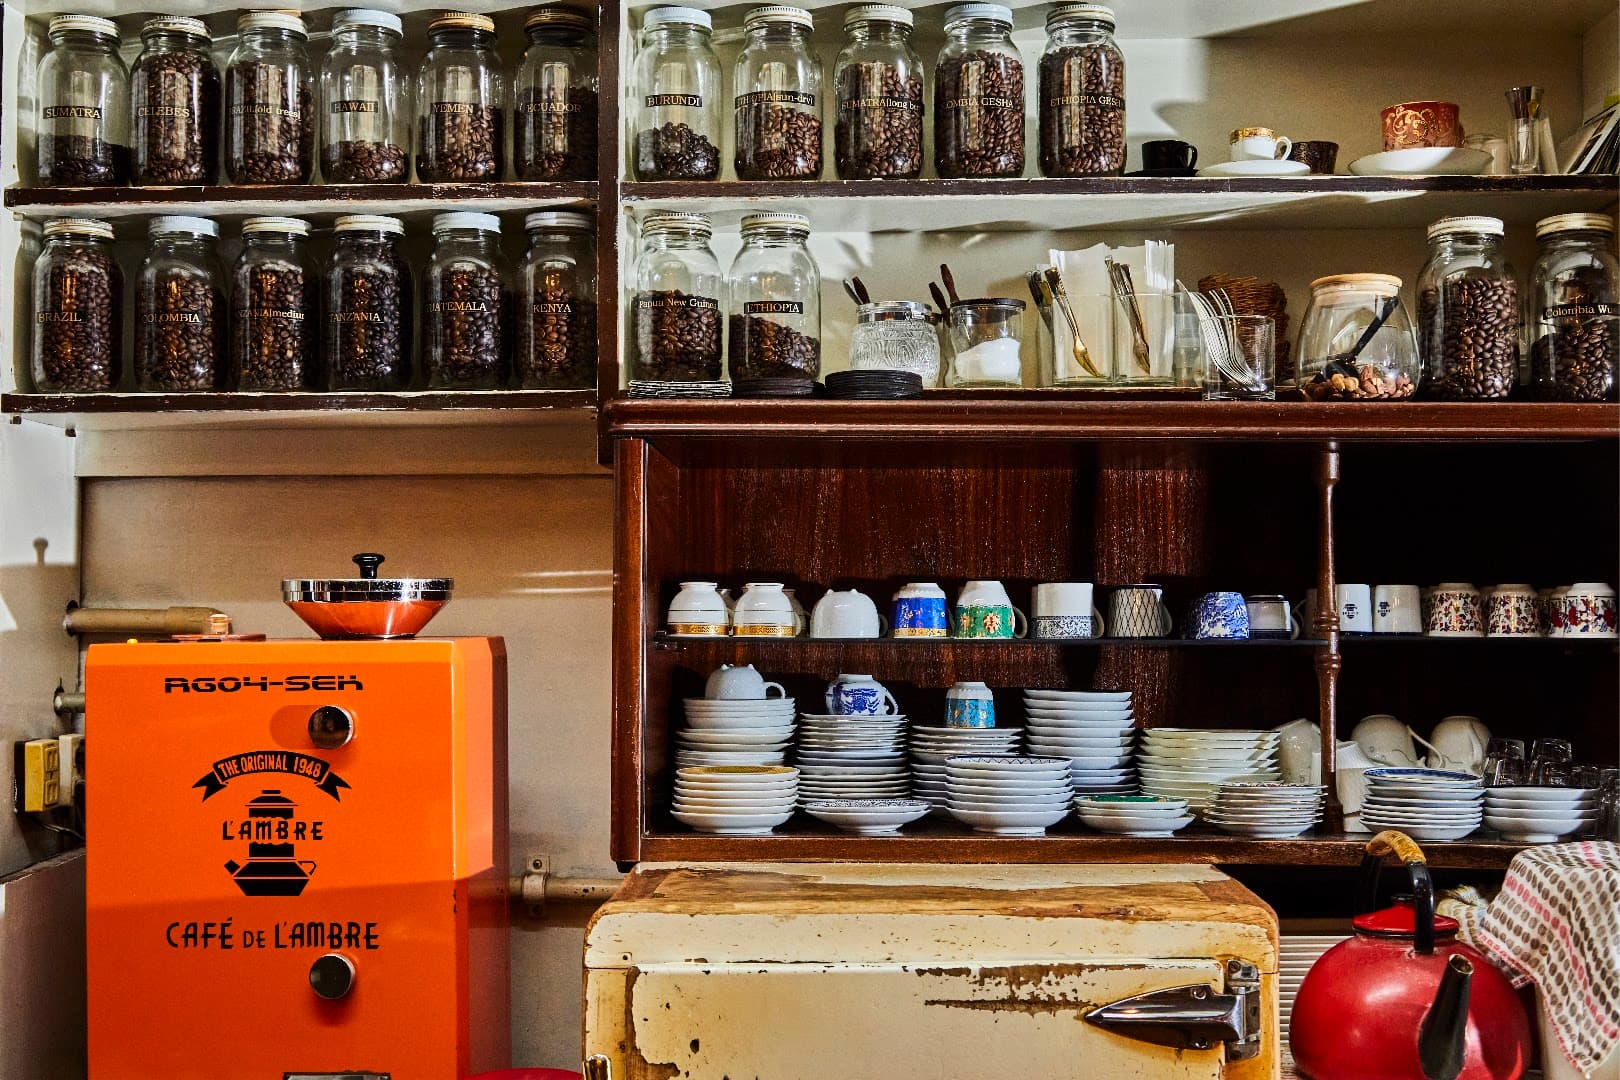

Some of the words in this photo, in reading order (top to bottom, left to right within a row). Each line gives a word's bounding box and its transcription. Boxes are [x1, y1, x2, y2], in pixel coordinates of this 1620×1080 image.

[334, 101, 375, 113] HAWAII
[647, 95, 700, 107] BURUNDI
[981, 97, 1014, 109] GESHA
[1050, 95, 1097, 108] ETHIOPIA
[45, 106, 101, 119] SUMATRA
[138, 106, 190, 118] CELEBES
[433, 103, 474, 114] YEMEN
[527, 102, 583, 113] ECUADOR
[533, 303, 572, 314] KENYA
[667, 298, 686, 307] New
[747, 302, 800, 314] ETHIOPIA
[38, 311, 82, 323] BRAZIL
[1545, 305, 1596, 318] Colombia
[217, 759, 241, 778] THE
[240, 754, 288, 772] ORIGINAL
[293, 756, 322, 778] 1948
[222, 820, 324, 841] L'AMBRE
[166, 916, 233, 950] CAFÉ
[243, 930, 266, 949] DE
[274, 921, 380, 950] L'AMBRE
